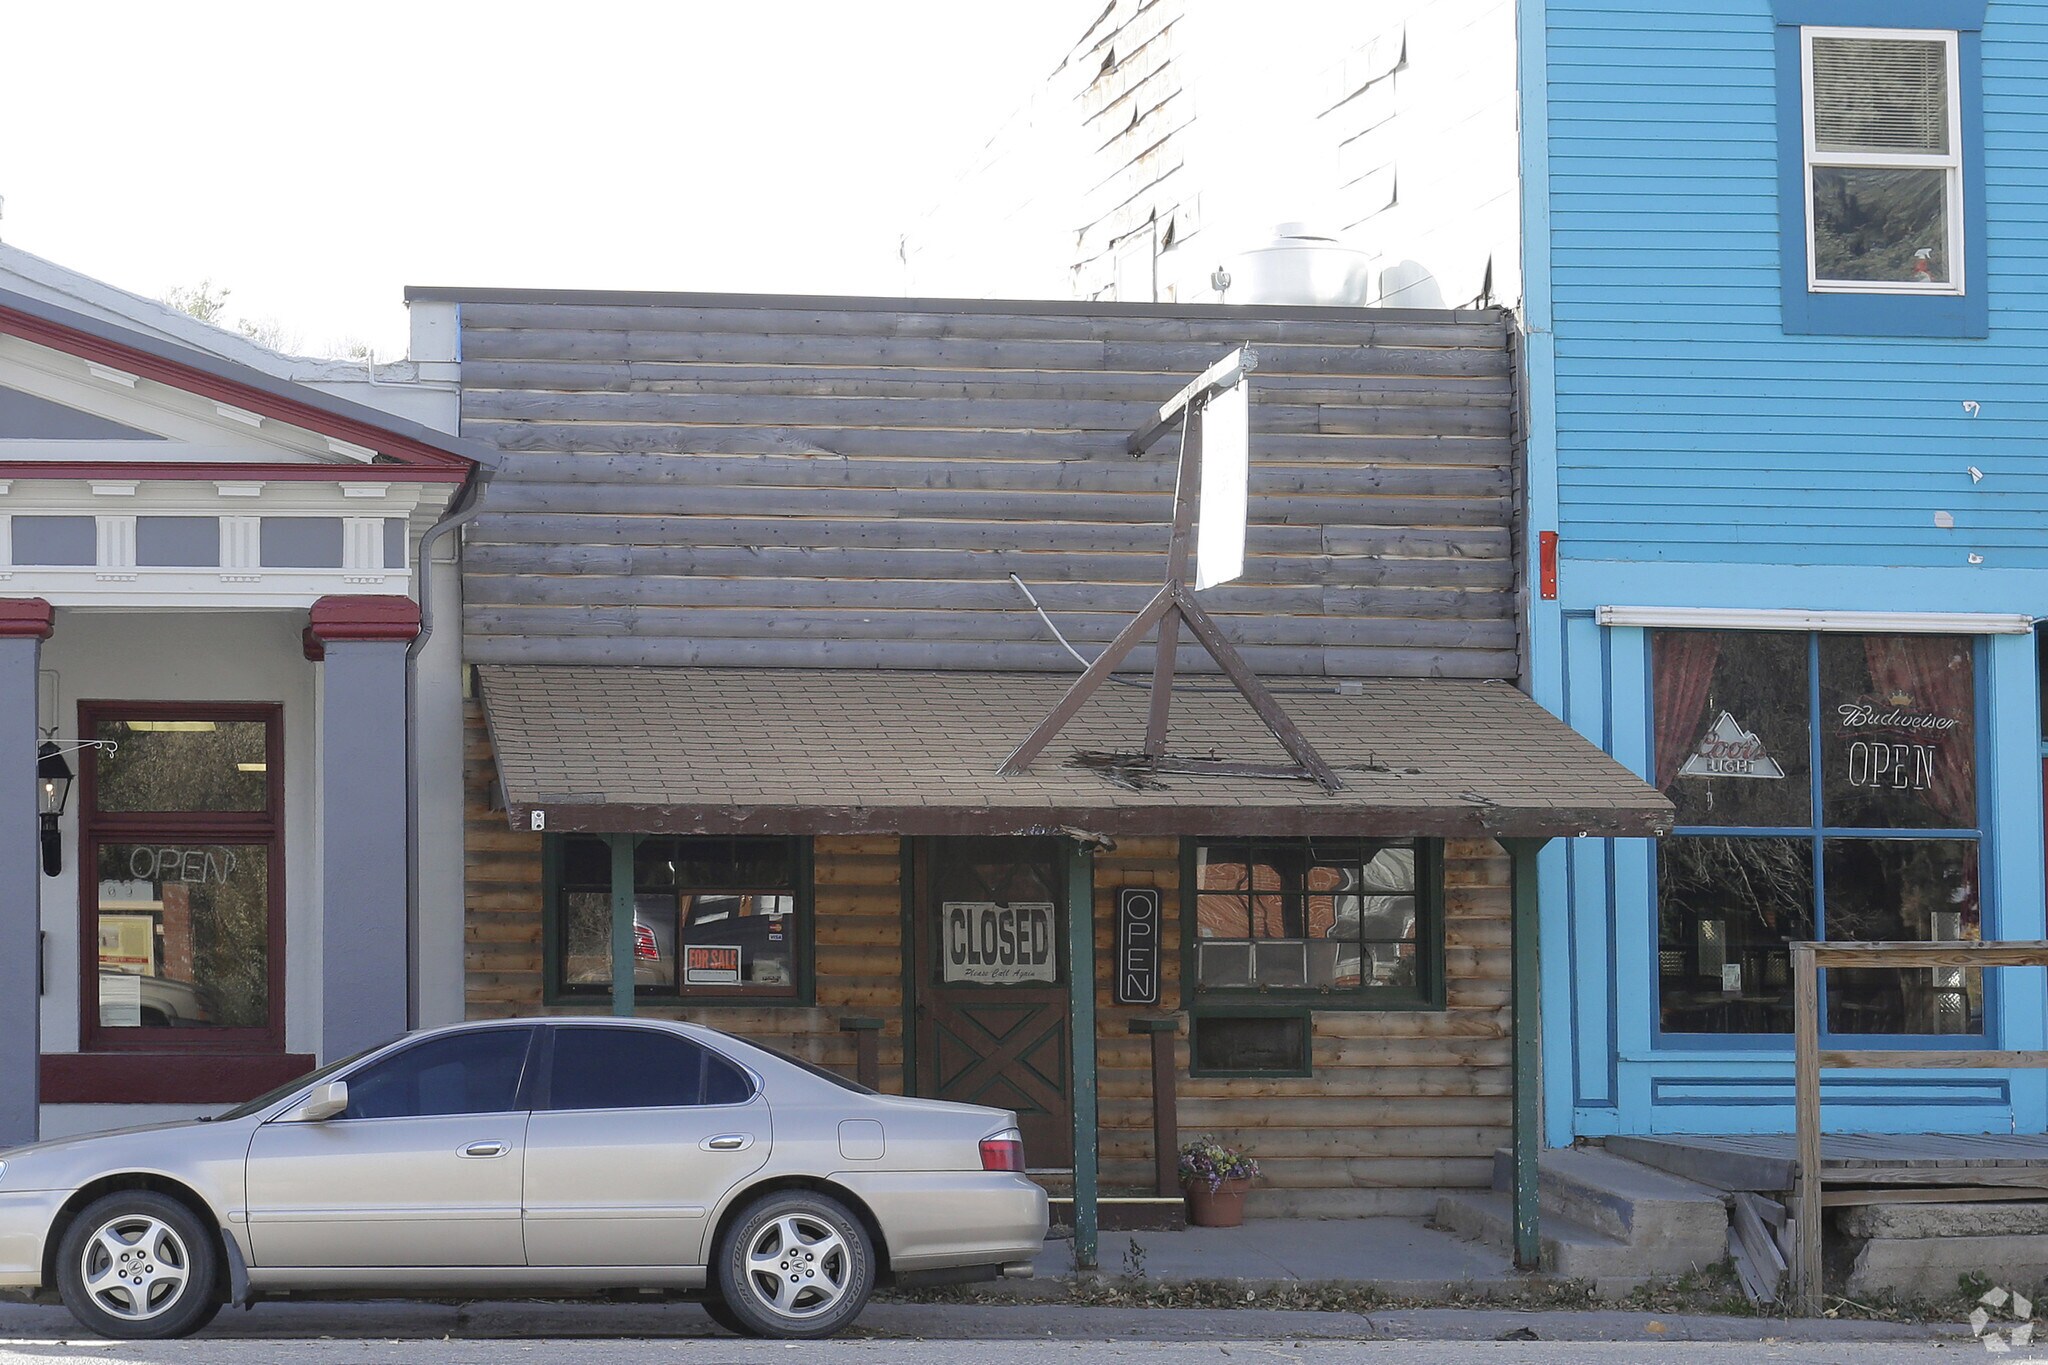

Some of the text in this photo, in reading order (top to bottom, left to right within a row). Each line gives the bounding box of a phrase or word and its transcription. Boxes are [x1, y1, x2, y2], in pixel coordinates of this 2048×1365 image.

[1837, 703, 1960, 730] Budweiser
[1701, 731, 1767, 760] Coors
[1708, 759, 1755, 774] LIGHT
[1848, 741, 1936, 790] OPEN
[129, 846, 231, 885] OPEN
[950, 907, 1049, 966] CLOSED
[1126, 894, 1153, 998] OPEN
[688, 949, 738, 970] FOR SALE
[964, 967, 1036, 979] Please Call Again
[733, 1213, 762, 1270] TOURING
[834, 1221, 865, 1319] MASTERCRAFT
